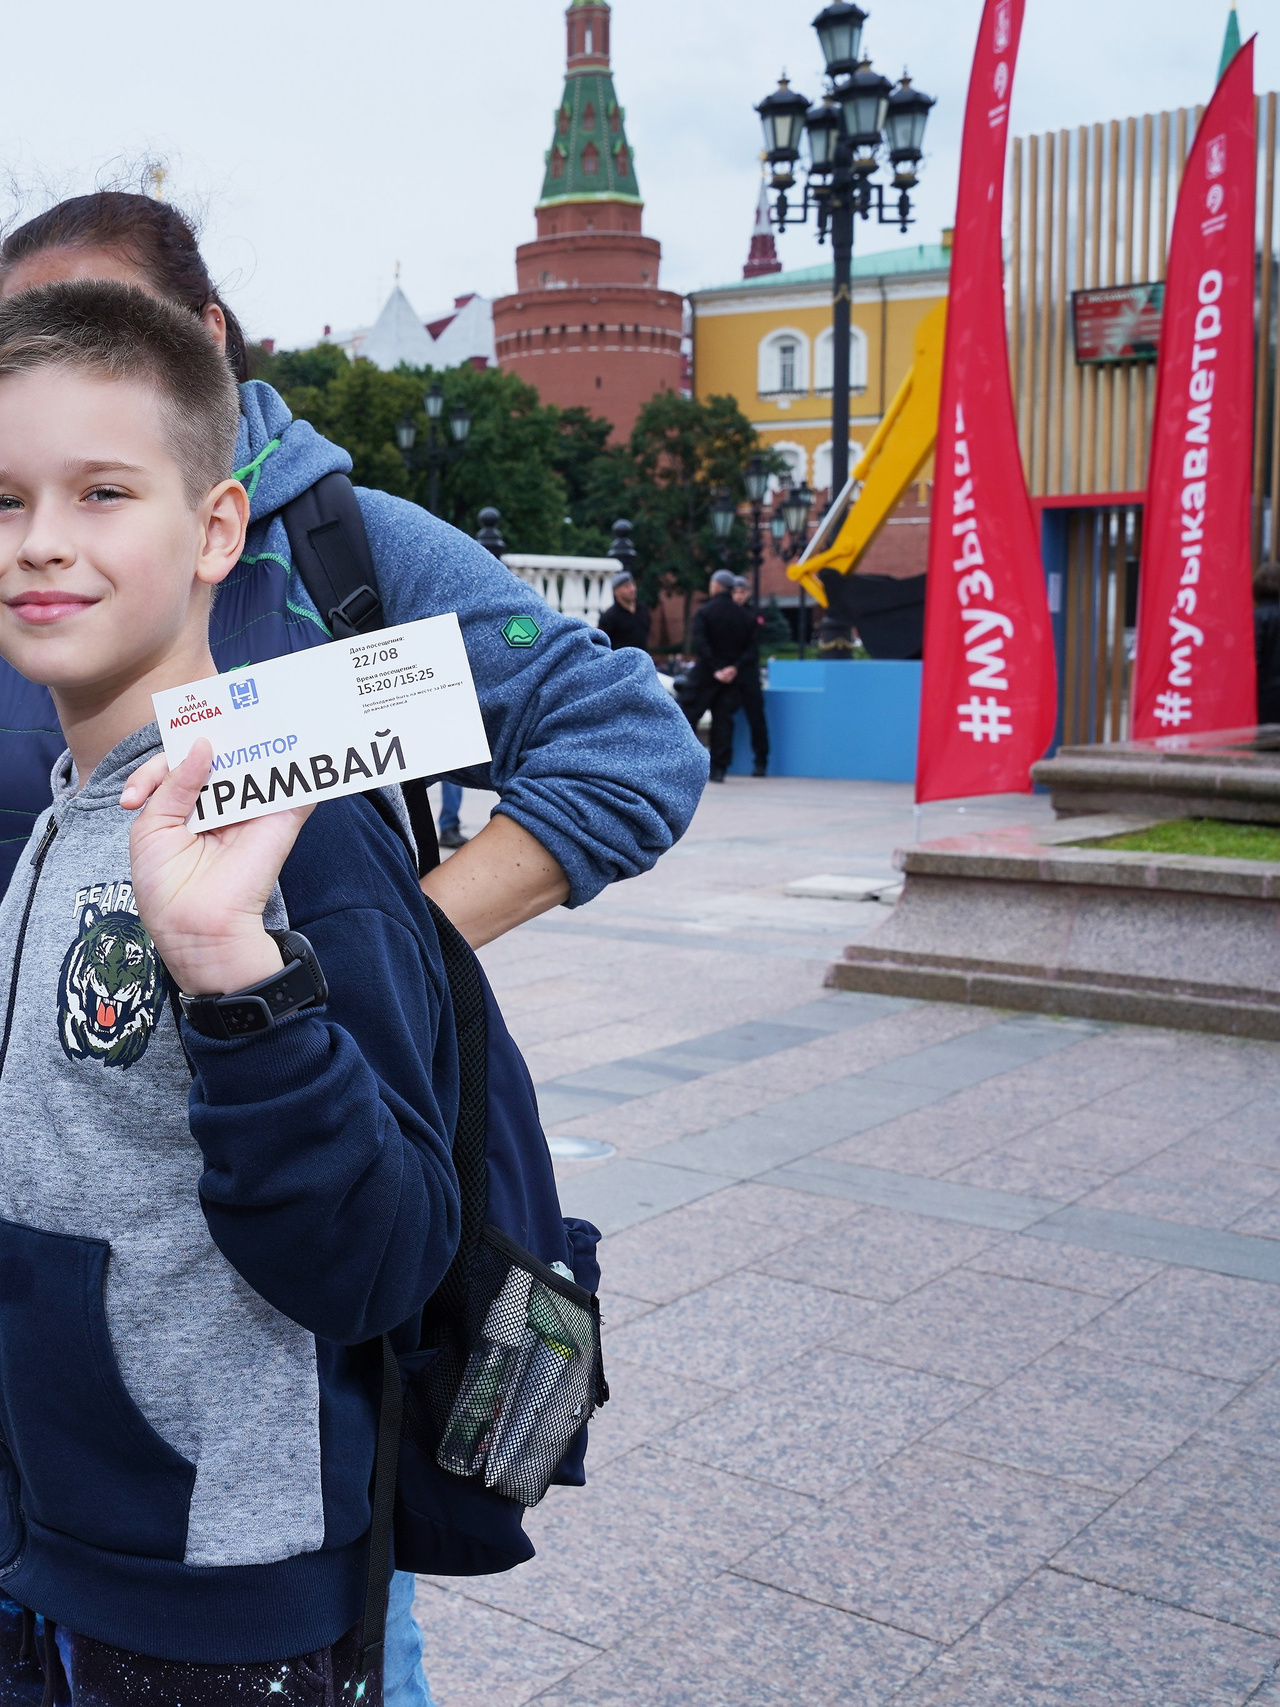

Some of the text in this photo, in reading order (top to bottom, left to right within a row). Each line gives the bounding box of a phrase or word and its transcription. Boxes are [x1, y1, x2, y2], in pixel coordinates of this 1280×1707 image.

[349, 636, 405, 655] Дата посещения:
[352, 647, 399, 669] 22/08
[356, 663, 418, 684] Время посещения:
[357, 667, 435, 696] 15:20/15:25
[178, 700, 208, 714] САМАЯ
[185, 694, 196, 702] ТА
[170, 706, 222, 729] МОСКВА
[209, 734, 298, 772] МУЛЯТОР
[195, 728, 406, 821] ТРАМВАЙ
[72, 881, 139, 919] FEARL
